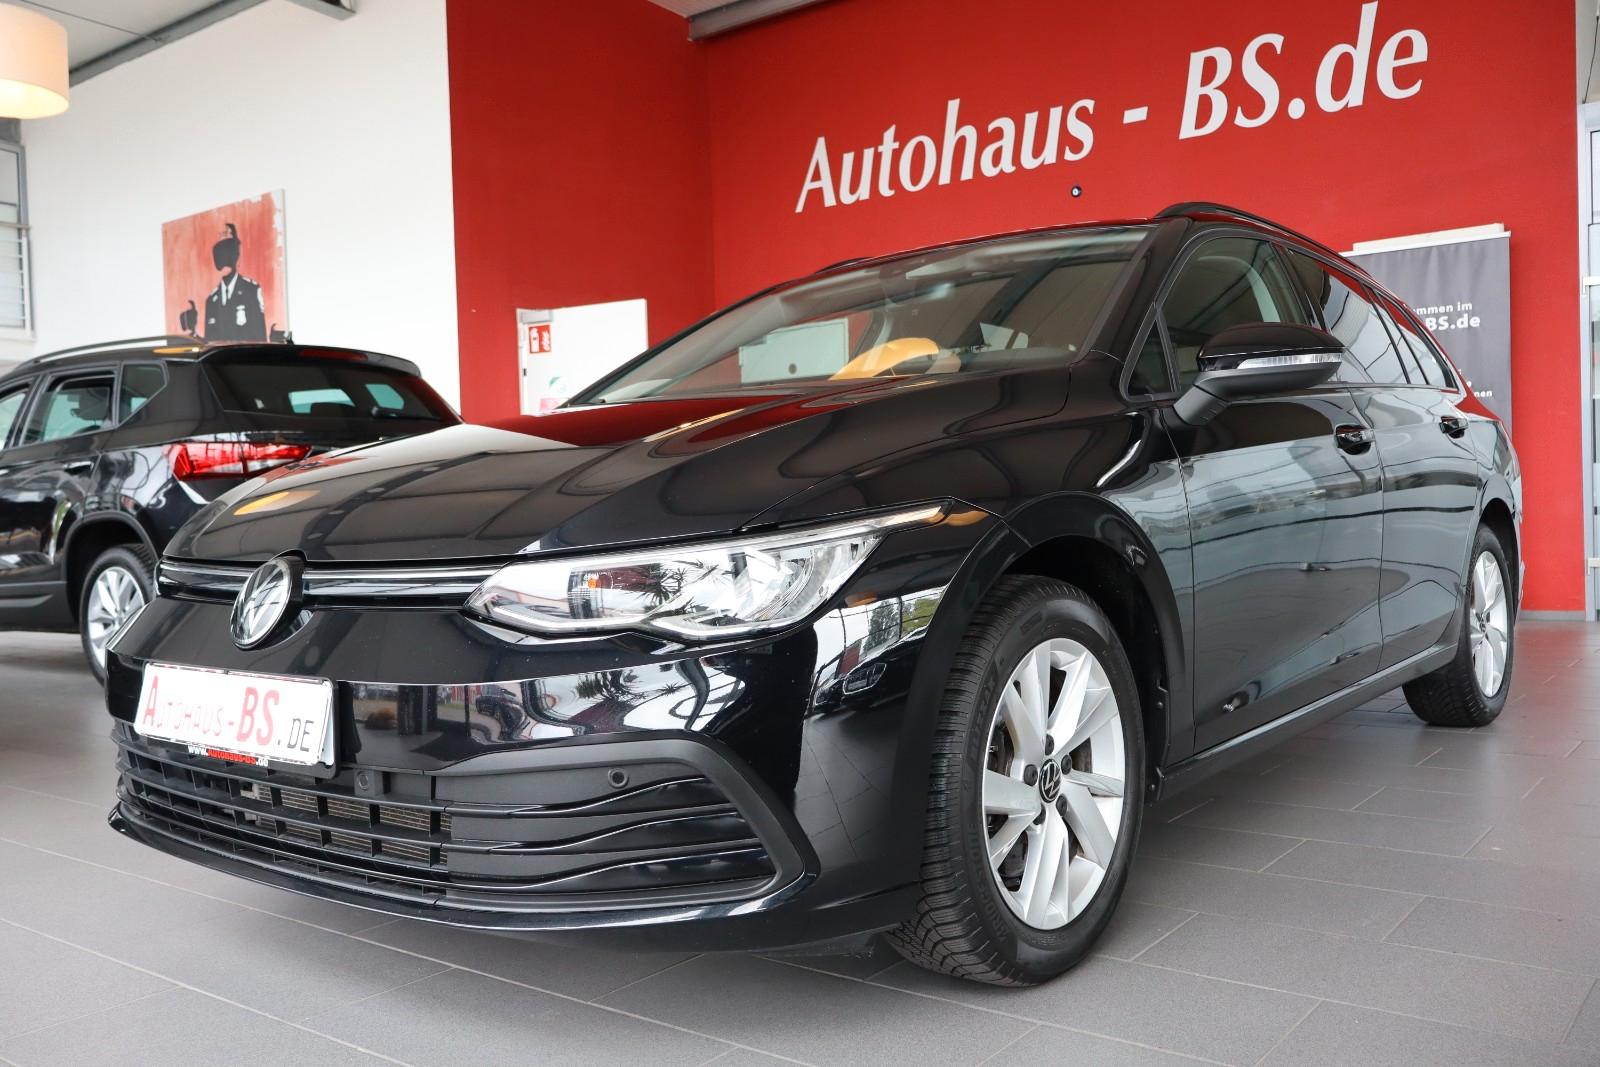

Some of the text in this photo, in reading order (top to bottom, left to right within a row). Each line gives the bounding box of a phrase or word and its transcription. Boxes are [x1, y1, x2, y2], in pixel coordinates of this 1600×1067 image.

[795, 1, 1429, 212] Autohaus - BS.de
[1413, 302, 1472, 315] mmen im
[1425, 313, 1480, 331] BS.de
